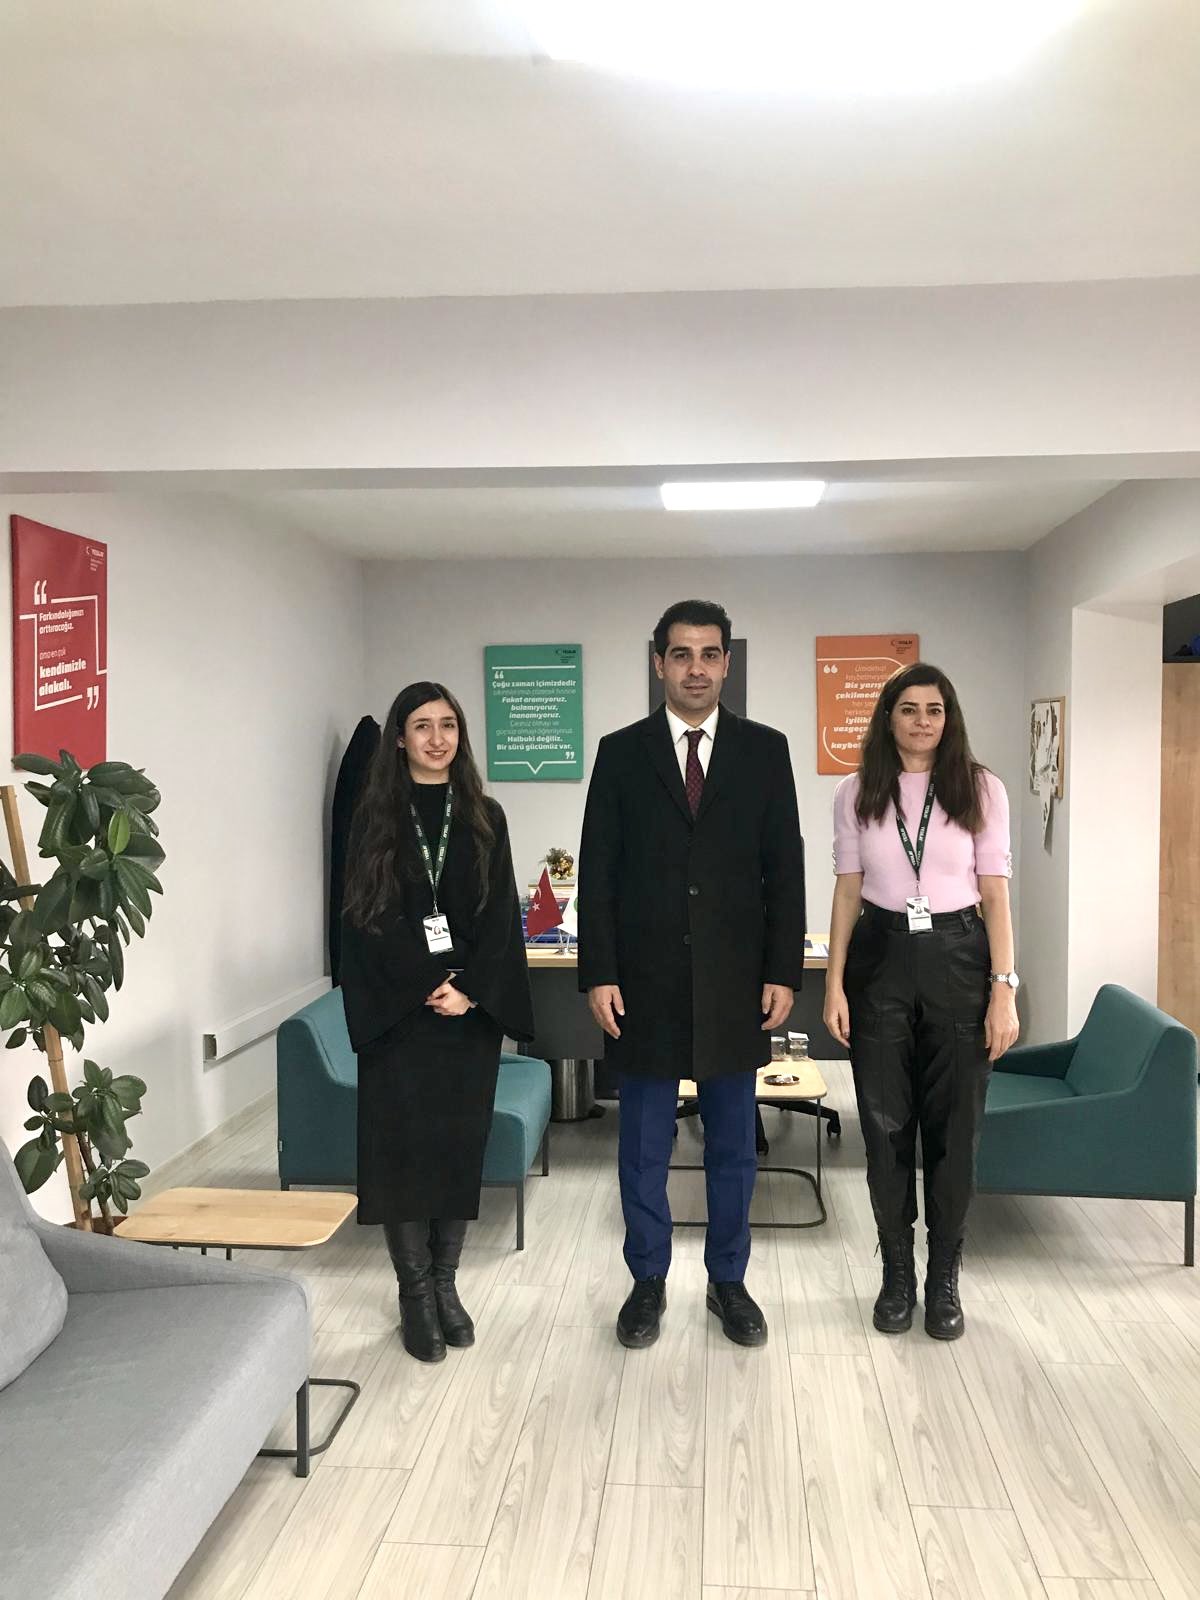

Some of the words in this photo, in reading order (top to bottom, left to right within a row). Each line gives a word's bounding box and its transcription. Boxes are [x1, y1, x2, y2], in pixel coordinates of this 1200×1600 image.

[40, 658, 86, 678] kendimizle
[492, 681, 510, 689] Çoğu
[536, 680, 576, 688] içimizdedir
[525, 744, 558, 752] gücümüz
